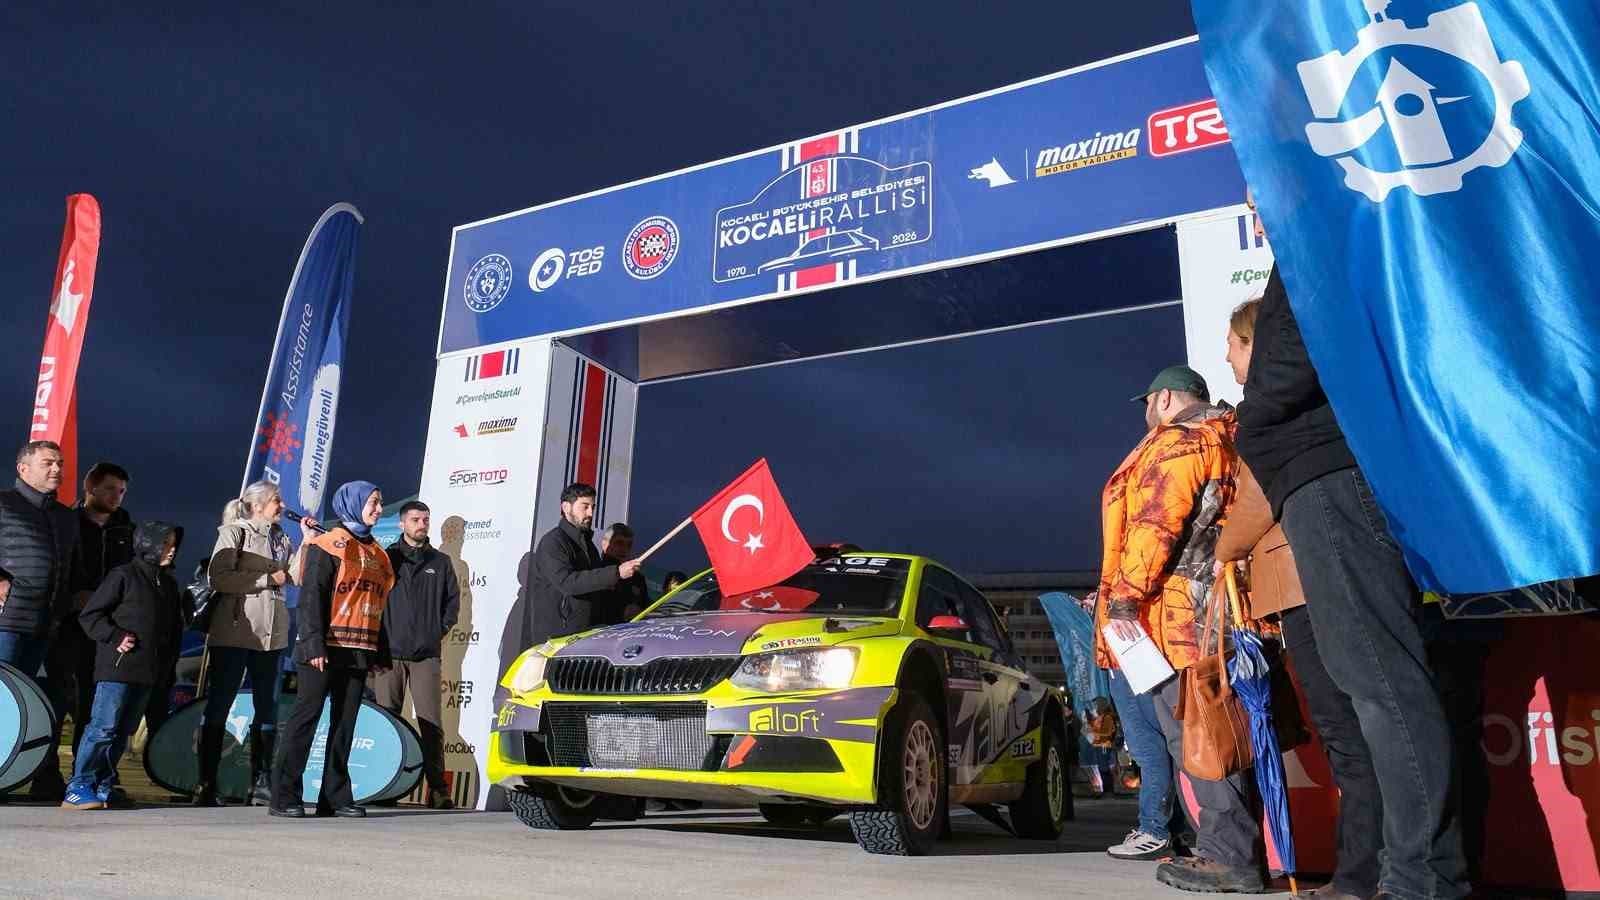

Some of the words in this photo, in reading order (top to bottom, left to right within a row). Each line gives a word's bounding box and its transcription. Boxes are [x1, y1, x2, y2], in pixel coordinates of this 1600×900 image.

[1036, 128, 1141, 168] maxima
[1045, 162, 1079, 174] MOTOR
[891, 231, 918, 245] 2026
[568, 245, 605, 264] TOS
[565, 259, 602, 280] FED
[726, 266, 747, 279] 1970
[281, 303, 313, 410] Assistance
[478, 416, 518, 431] maxima
[463, 518, 492, 530] Remed
[450, 628, 480, 642] Fora
[447, 695, 472, 709] APP
[749, 705, 819, 733] aloft
